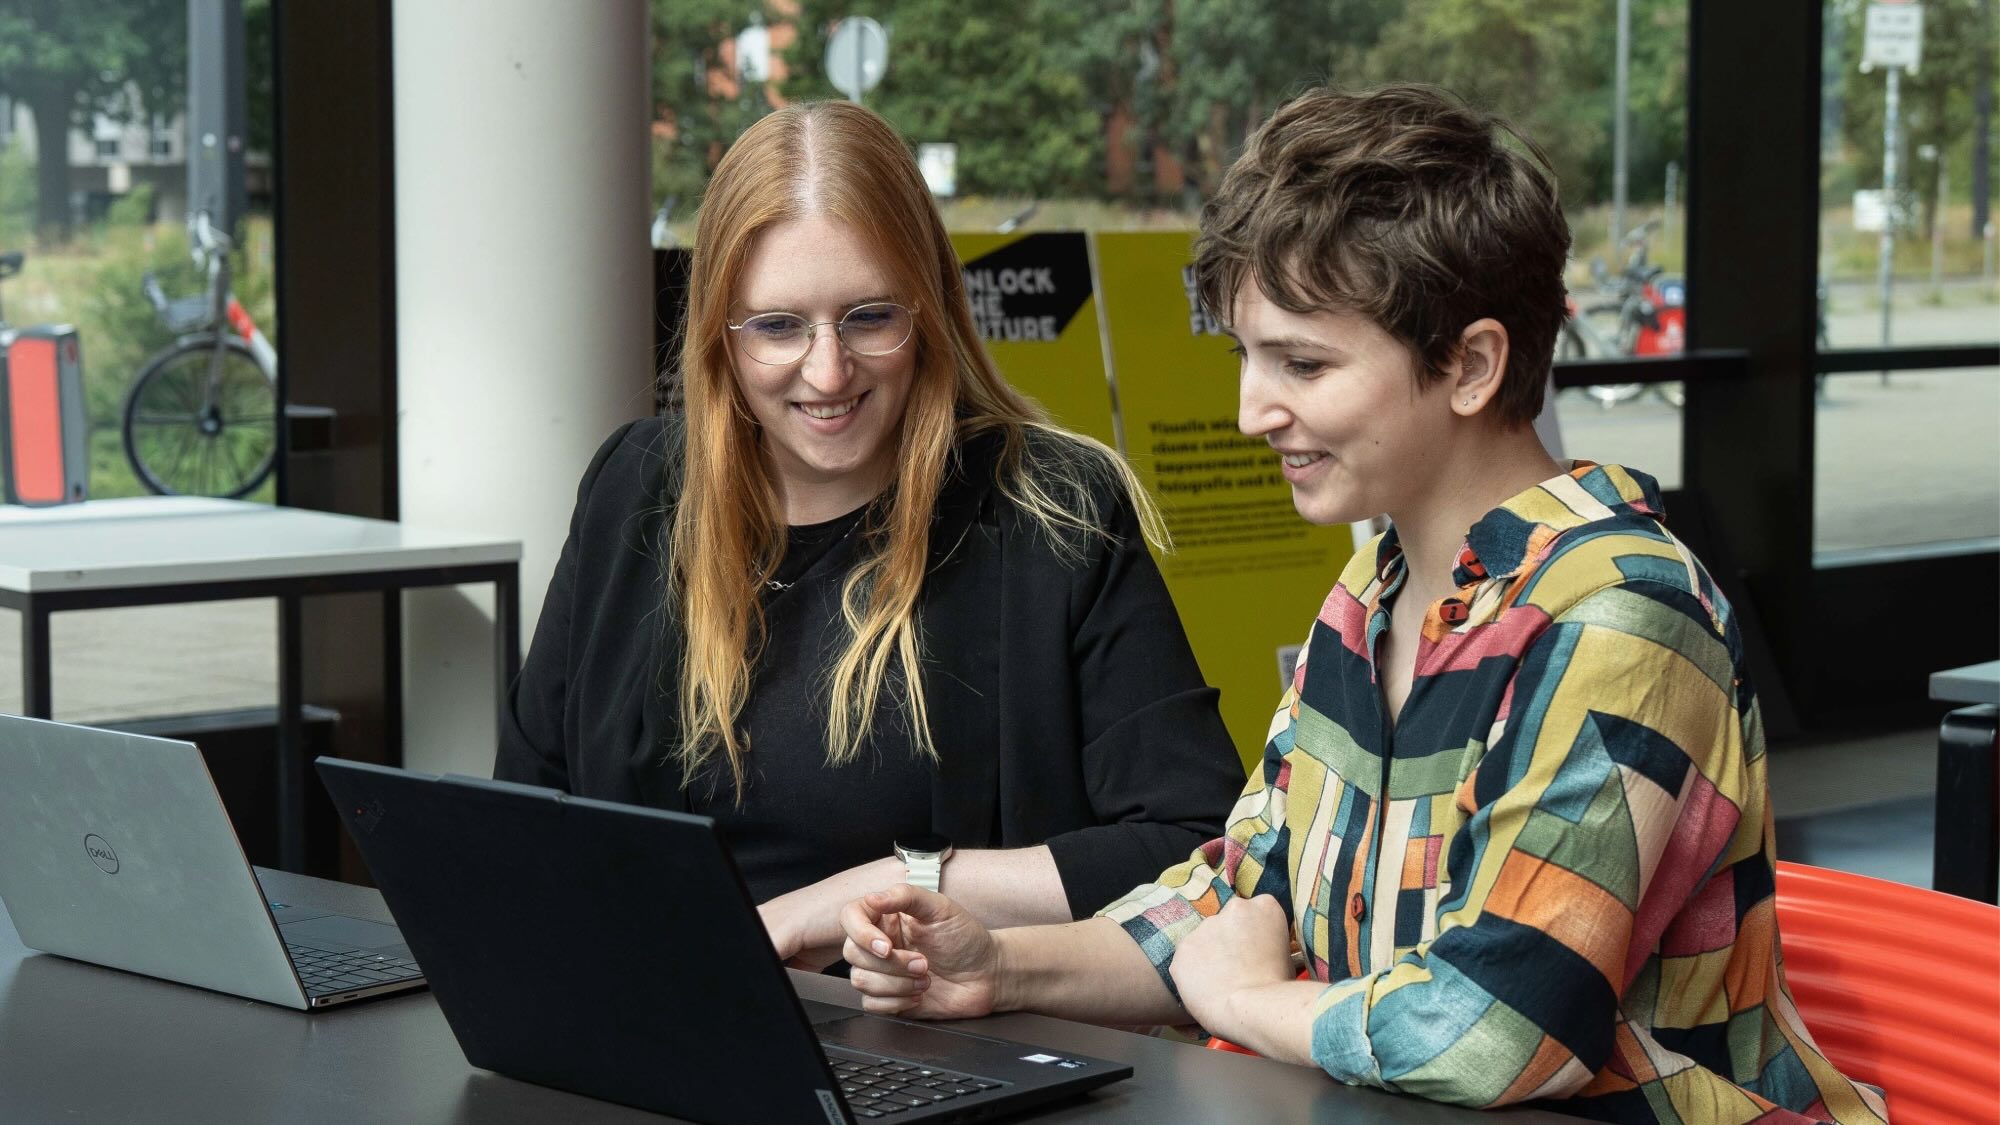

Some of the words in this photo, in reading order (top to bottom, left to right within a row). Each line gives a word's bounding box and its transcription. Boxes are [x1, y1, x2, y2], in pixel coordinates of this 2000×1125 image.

[965, 268, 1056, 294] NLOCK
[968, 291, 1005, 317] HE
[1237, 474, 1263, 488] und
[89, 847, 115, 860] DELL
